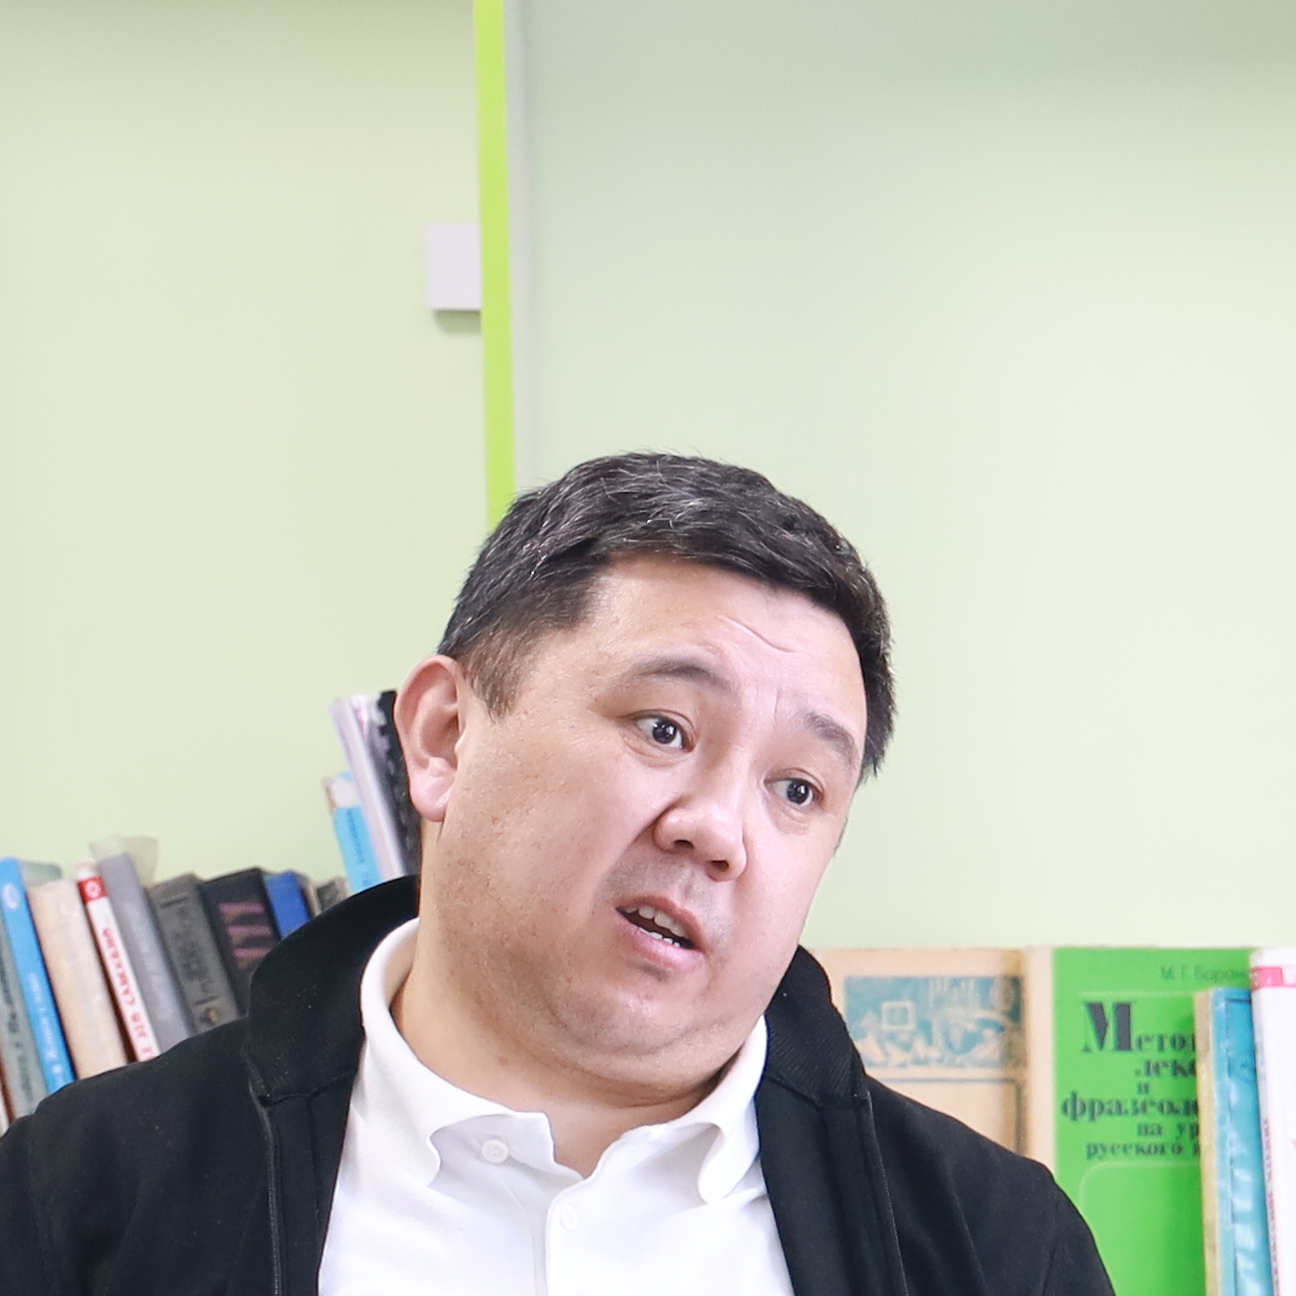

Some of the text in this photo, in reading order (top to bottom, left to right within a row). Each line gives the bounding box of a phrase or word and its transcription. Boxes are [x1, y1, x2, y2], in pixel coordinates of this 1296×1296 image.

[1081, 1001, 1194, 1052] Мето
[1137, 1082, 1150, 1096] и
[1137, 1123, 1163, 1137] на
[1086, 1142, 1184, 1161] русского
